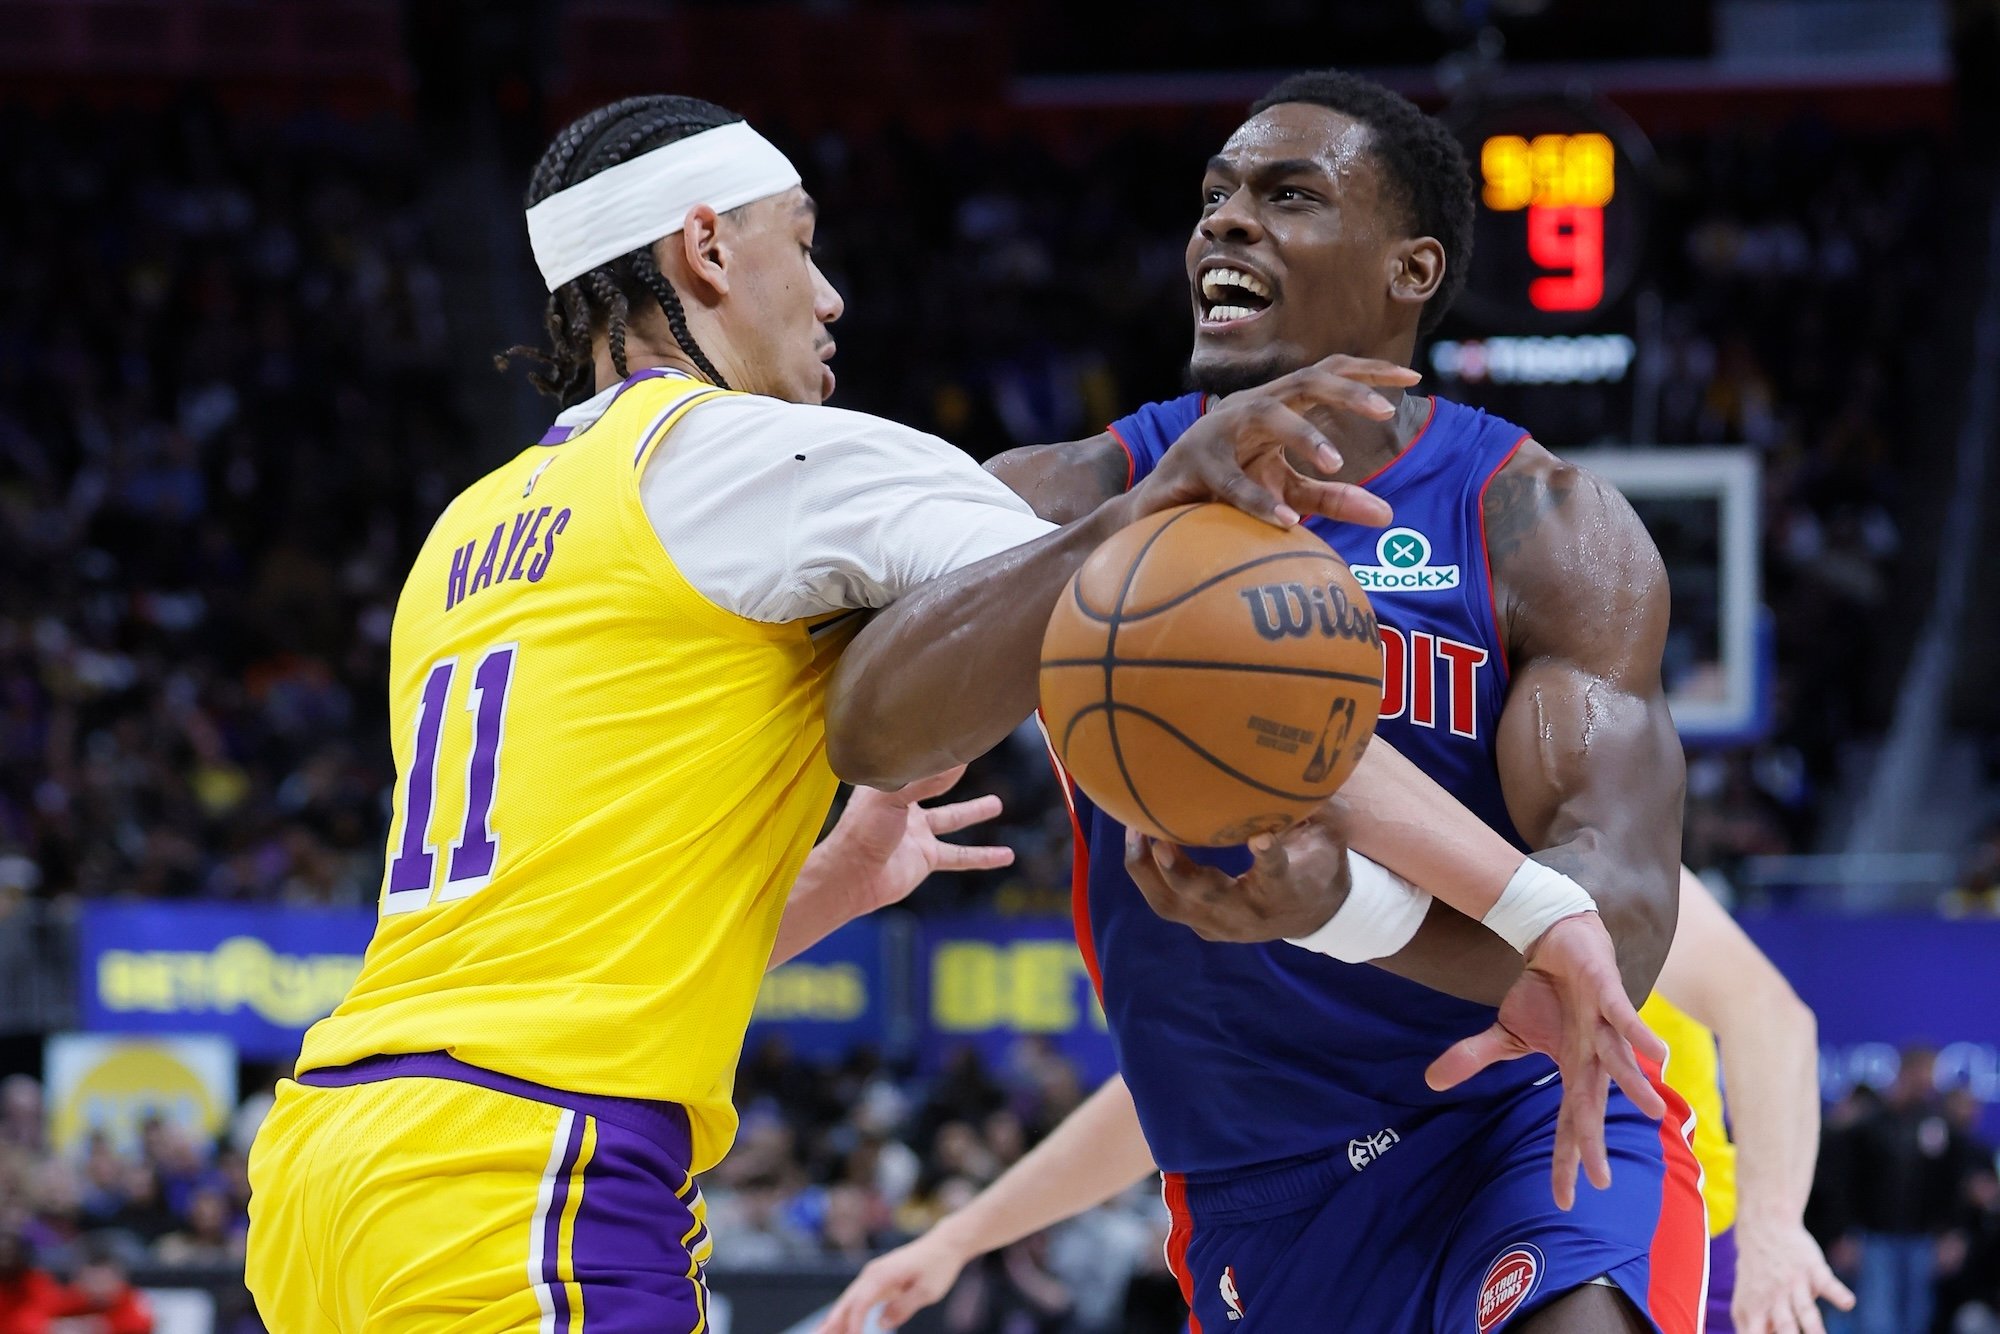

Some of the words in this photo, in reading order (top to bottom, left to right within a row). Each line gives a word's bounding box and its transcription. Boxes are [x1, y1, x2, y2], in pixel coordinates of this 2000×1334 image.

[1527, 202, 1605, 312] 9
[446, 506, 571, 611] HAYES
[1354, 569, 1454, 587] StockX
[383, 641, 519, 916] 11
[1480, 1280, 1524, 1321] PISTONS
[1483, 1266, 1526, 1306] DETROIT
